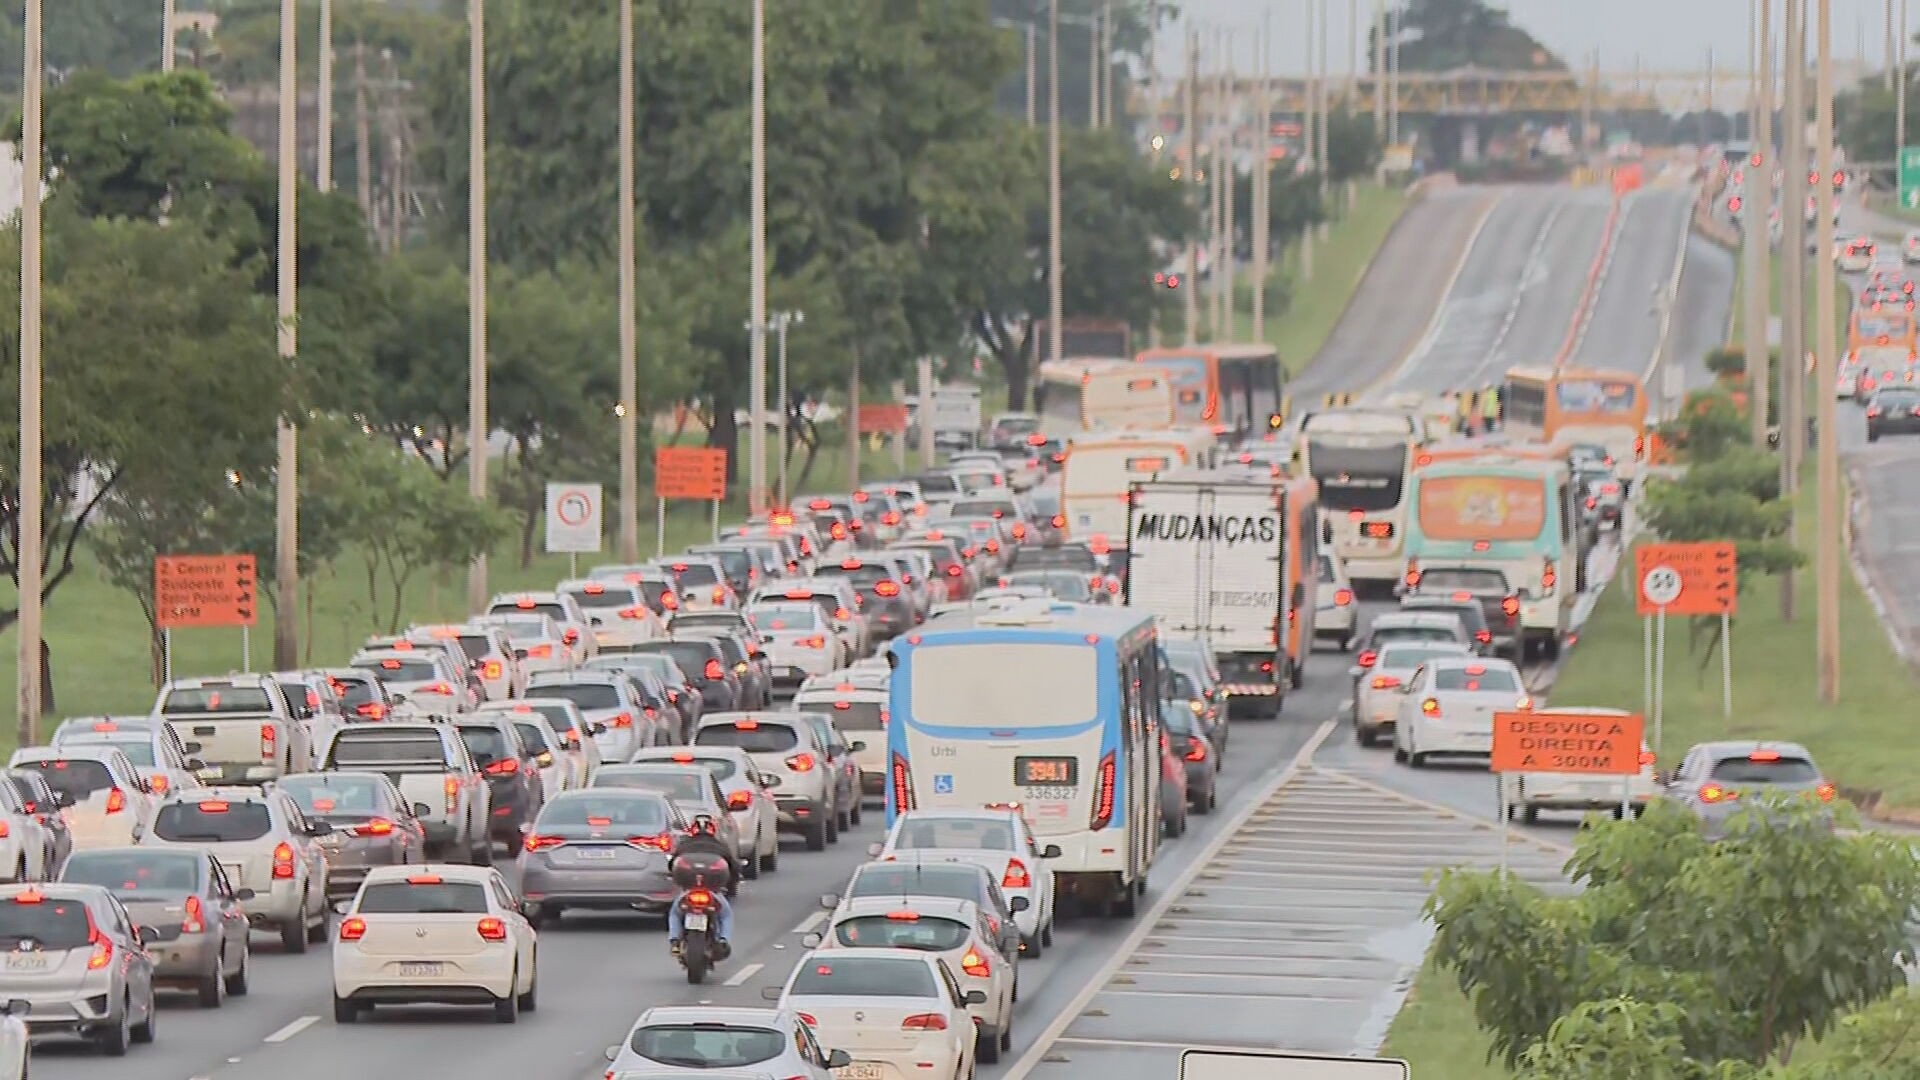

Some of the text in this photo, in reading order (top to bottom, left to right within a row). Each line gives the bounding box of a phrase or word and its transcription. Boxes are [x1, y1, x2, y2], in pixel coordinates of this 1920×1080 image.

[1136, 513, 1275, 548] MUDANÇAS
[176, 561, 227, 574] Central
[160, 578, 225, 591] Sudoeste
[1509, 721, 1624, 735] DESVIO A
[1520, 737, 1613, 751] DIREITA
[931, 745, 957, 757] Urbi
[1521, 754, 1611, 767] A 300M
[1025, 786, 1079, 800] 336327
